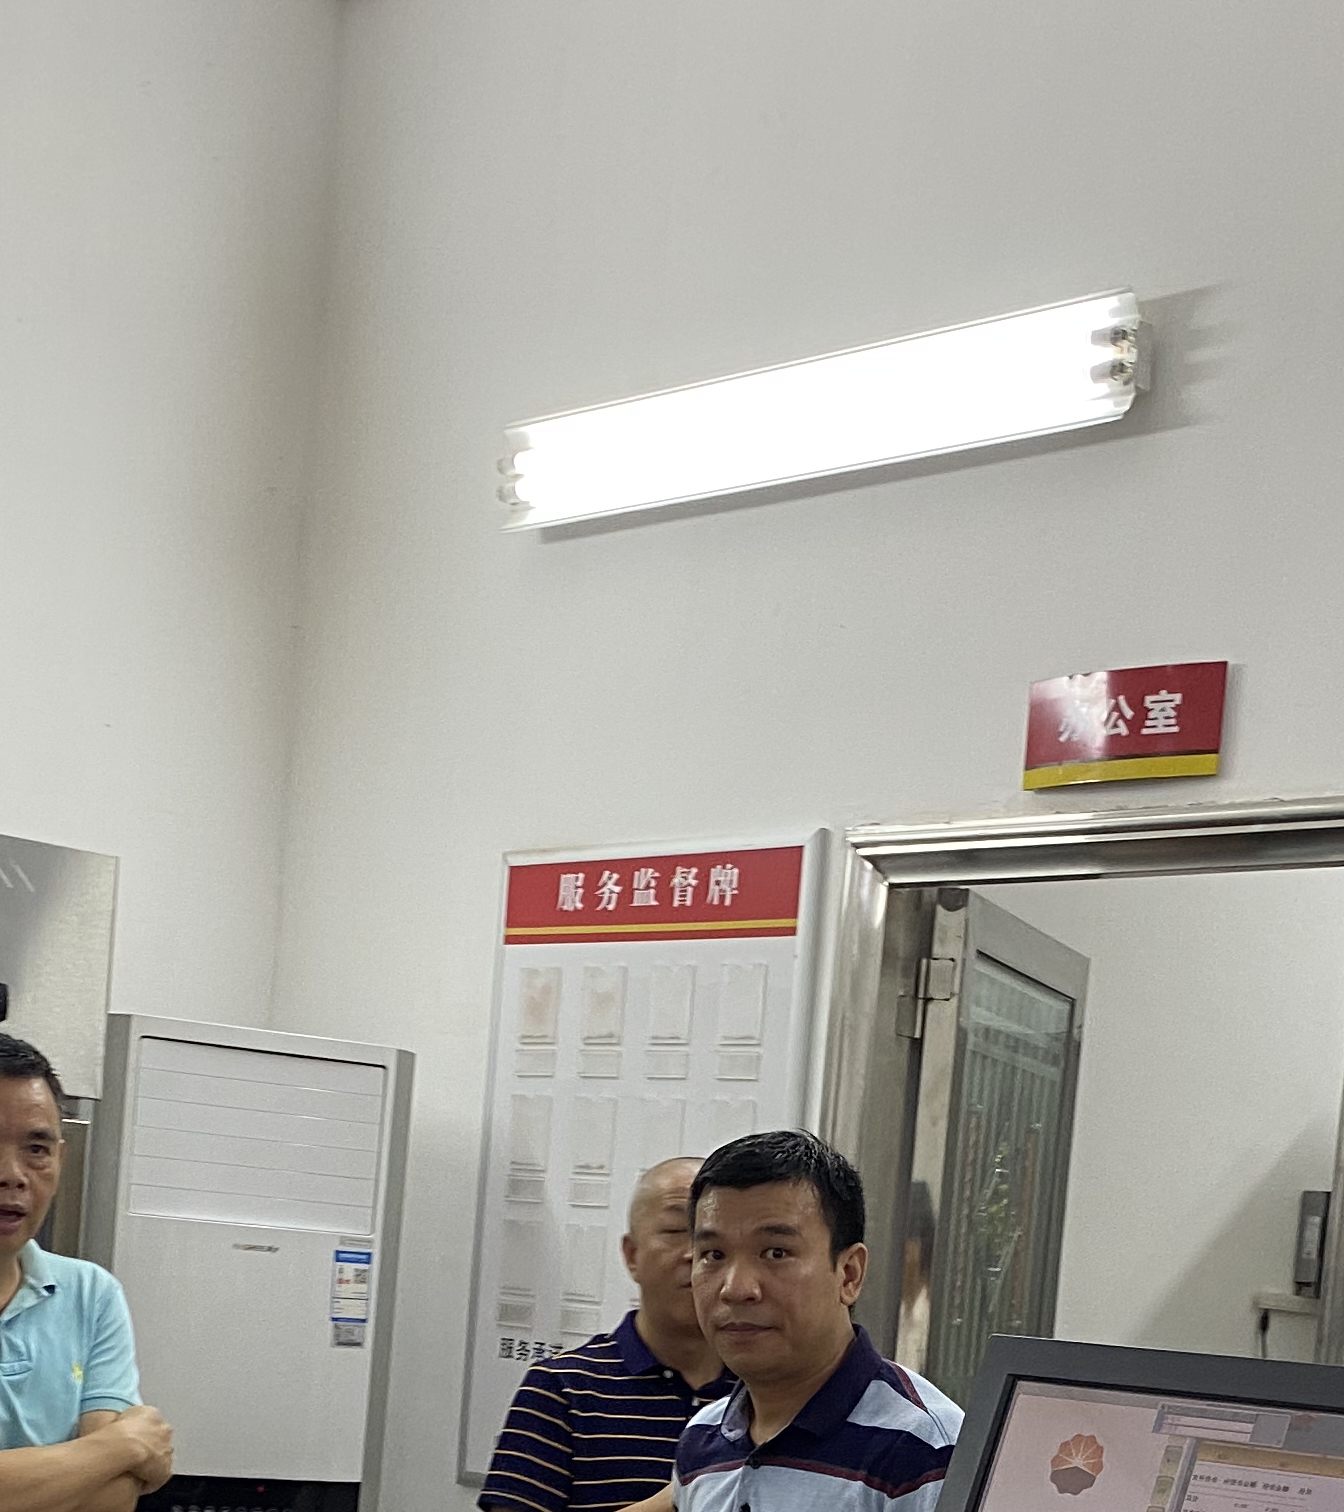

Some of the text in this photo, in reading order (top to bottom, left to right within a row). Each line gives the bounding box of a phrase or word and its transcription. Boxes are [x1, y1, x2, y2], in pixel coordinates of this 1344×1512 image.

[556, 863, 741, 912] 服务监督牌
